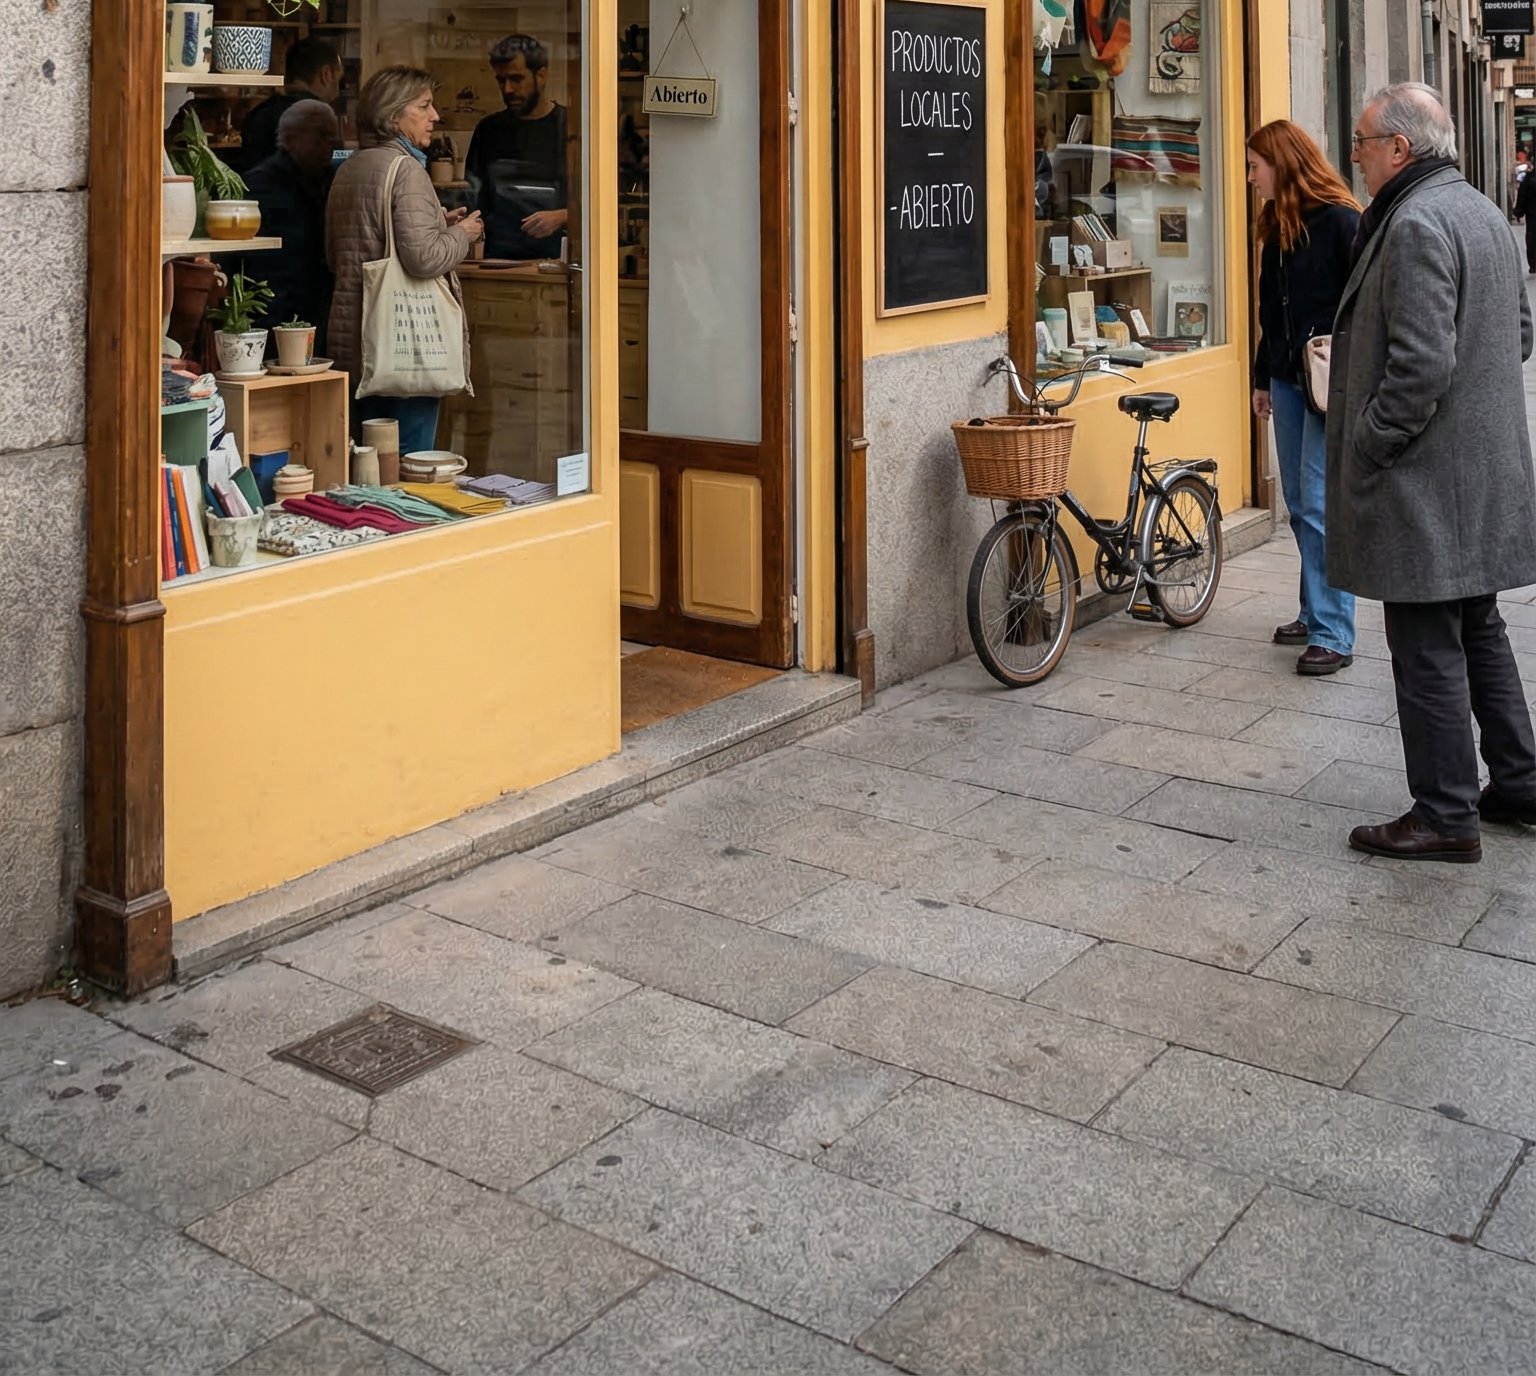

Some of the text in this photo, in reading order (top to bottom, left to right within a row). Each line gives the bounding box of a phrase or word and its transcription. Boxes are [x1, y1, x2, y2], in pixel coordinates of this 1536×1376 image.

[891, 29, 981, 78] PRODUCTOS
[650, 85, 708, 105] Abierto
[900, 89, 973, 131] LOCALES
